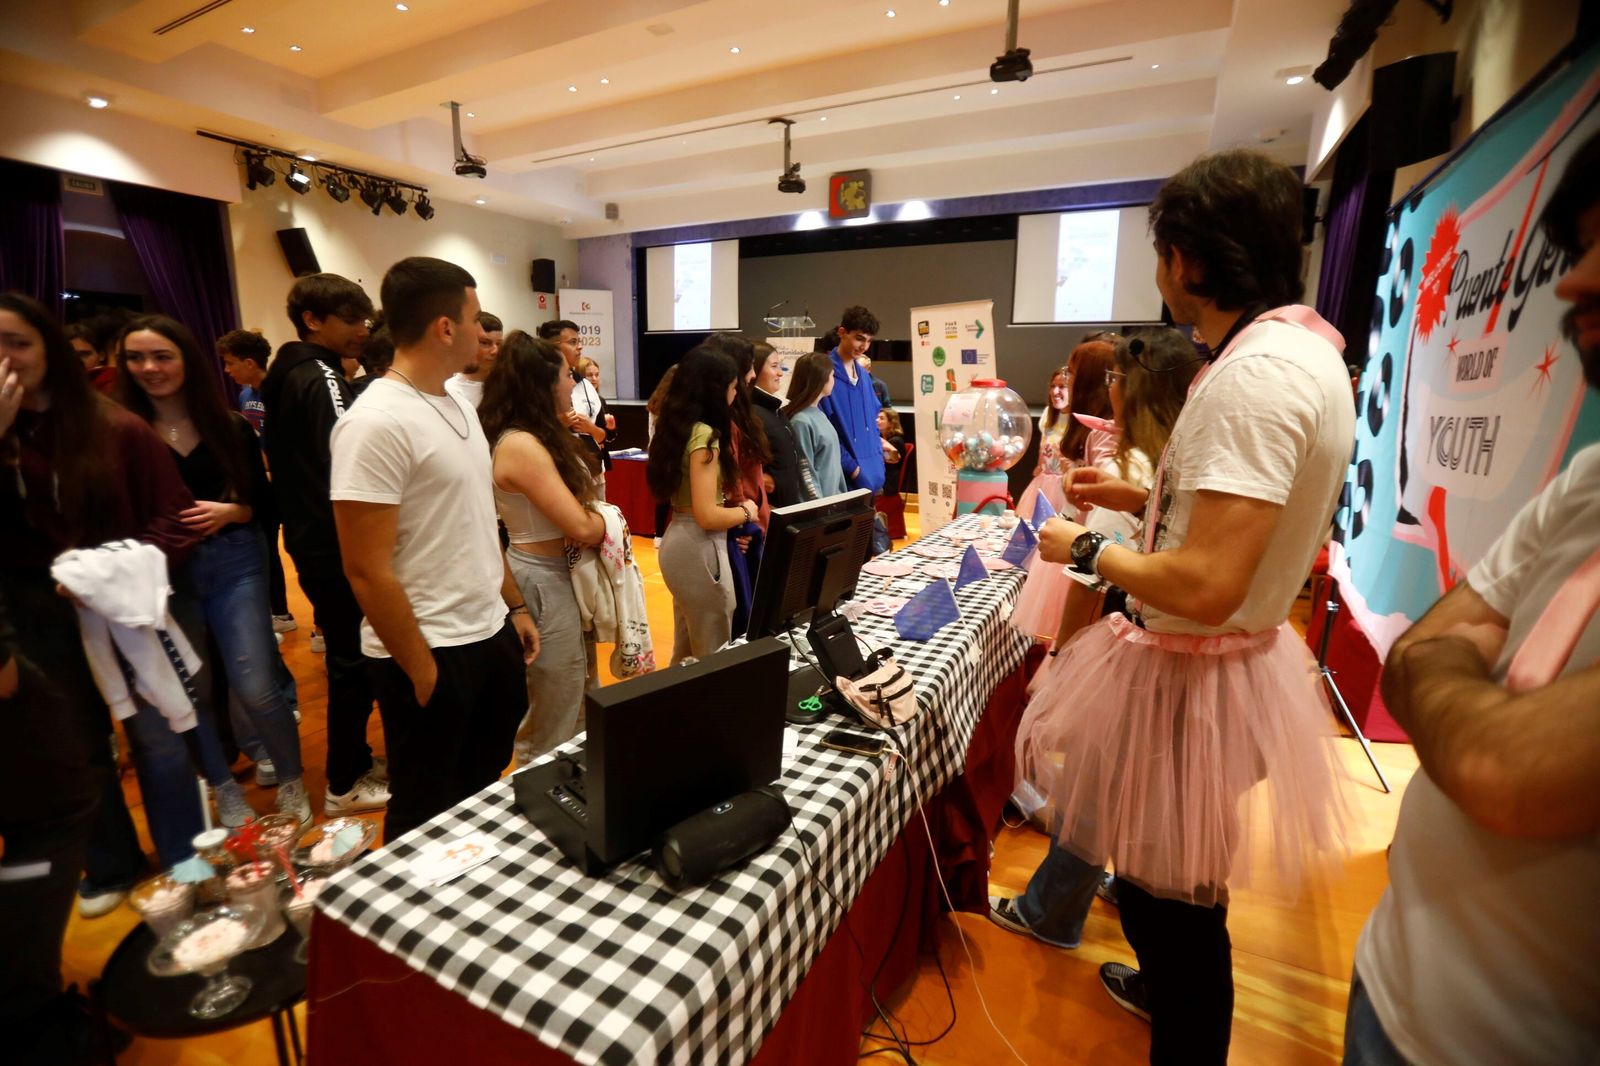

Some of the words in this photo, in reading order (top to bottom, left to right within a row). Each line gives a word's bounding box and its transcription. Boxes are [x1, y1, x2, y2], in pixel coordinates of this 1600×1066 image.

[1443, 229, 1515, 328] Puente
[577, 325, 601, 335] 019
[1456, 351, 1484, 382] WORLD
[1482, 347, 1499, 378] OF
[1427, 415, 1501, 477] YOUTH
